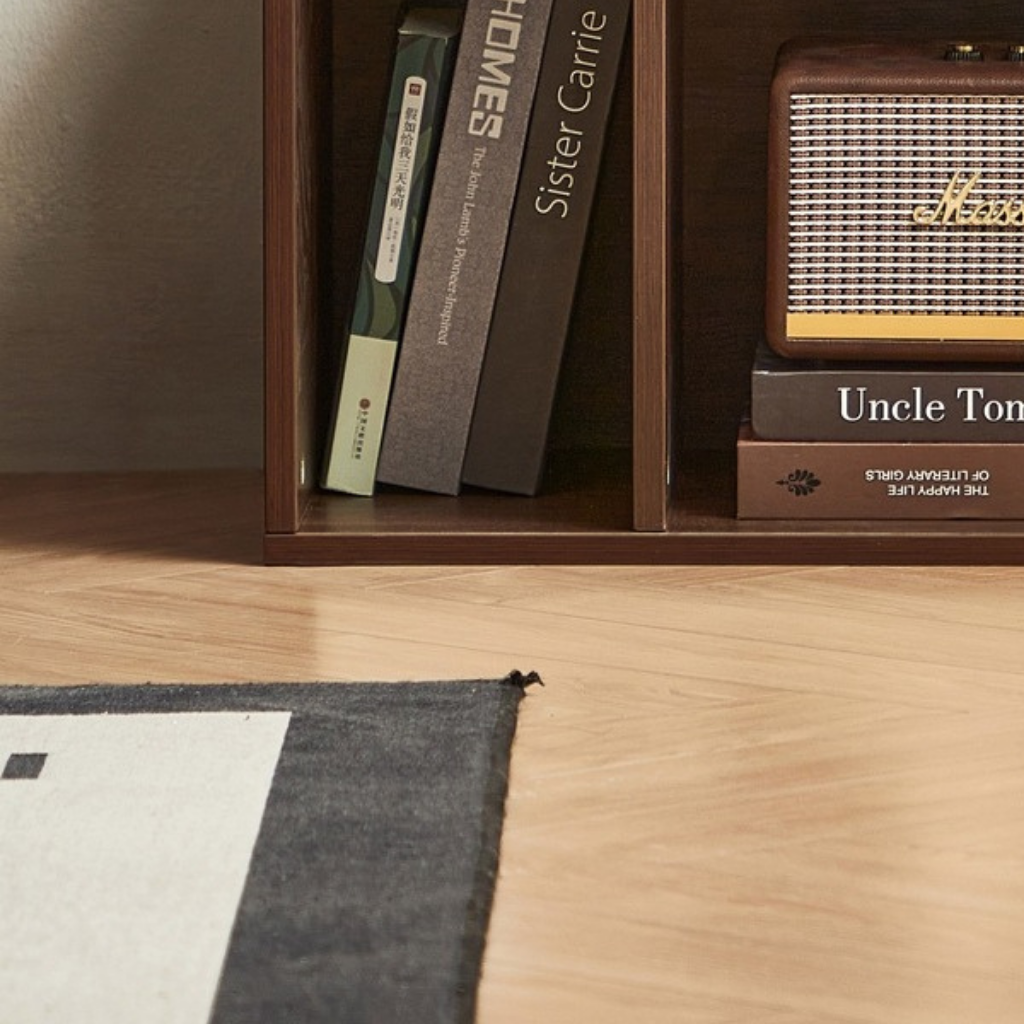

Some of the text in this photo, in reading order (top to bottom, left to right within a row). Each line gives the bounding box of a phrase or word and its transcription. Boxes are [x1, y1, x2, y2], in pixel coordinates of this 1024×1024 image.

[534, 10, 606, 218] Sister Carrie
[472, 146, 487, 168] The
[465, 170, 482, 199] John
[838, 386, 945, 423] Uncle
[865, 469, 990, 481] OF LITERARY GIRLS
[887, 484, 990, 496] THE HAPPY LIFE
